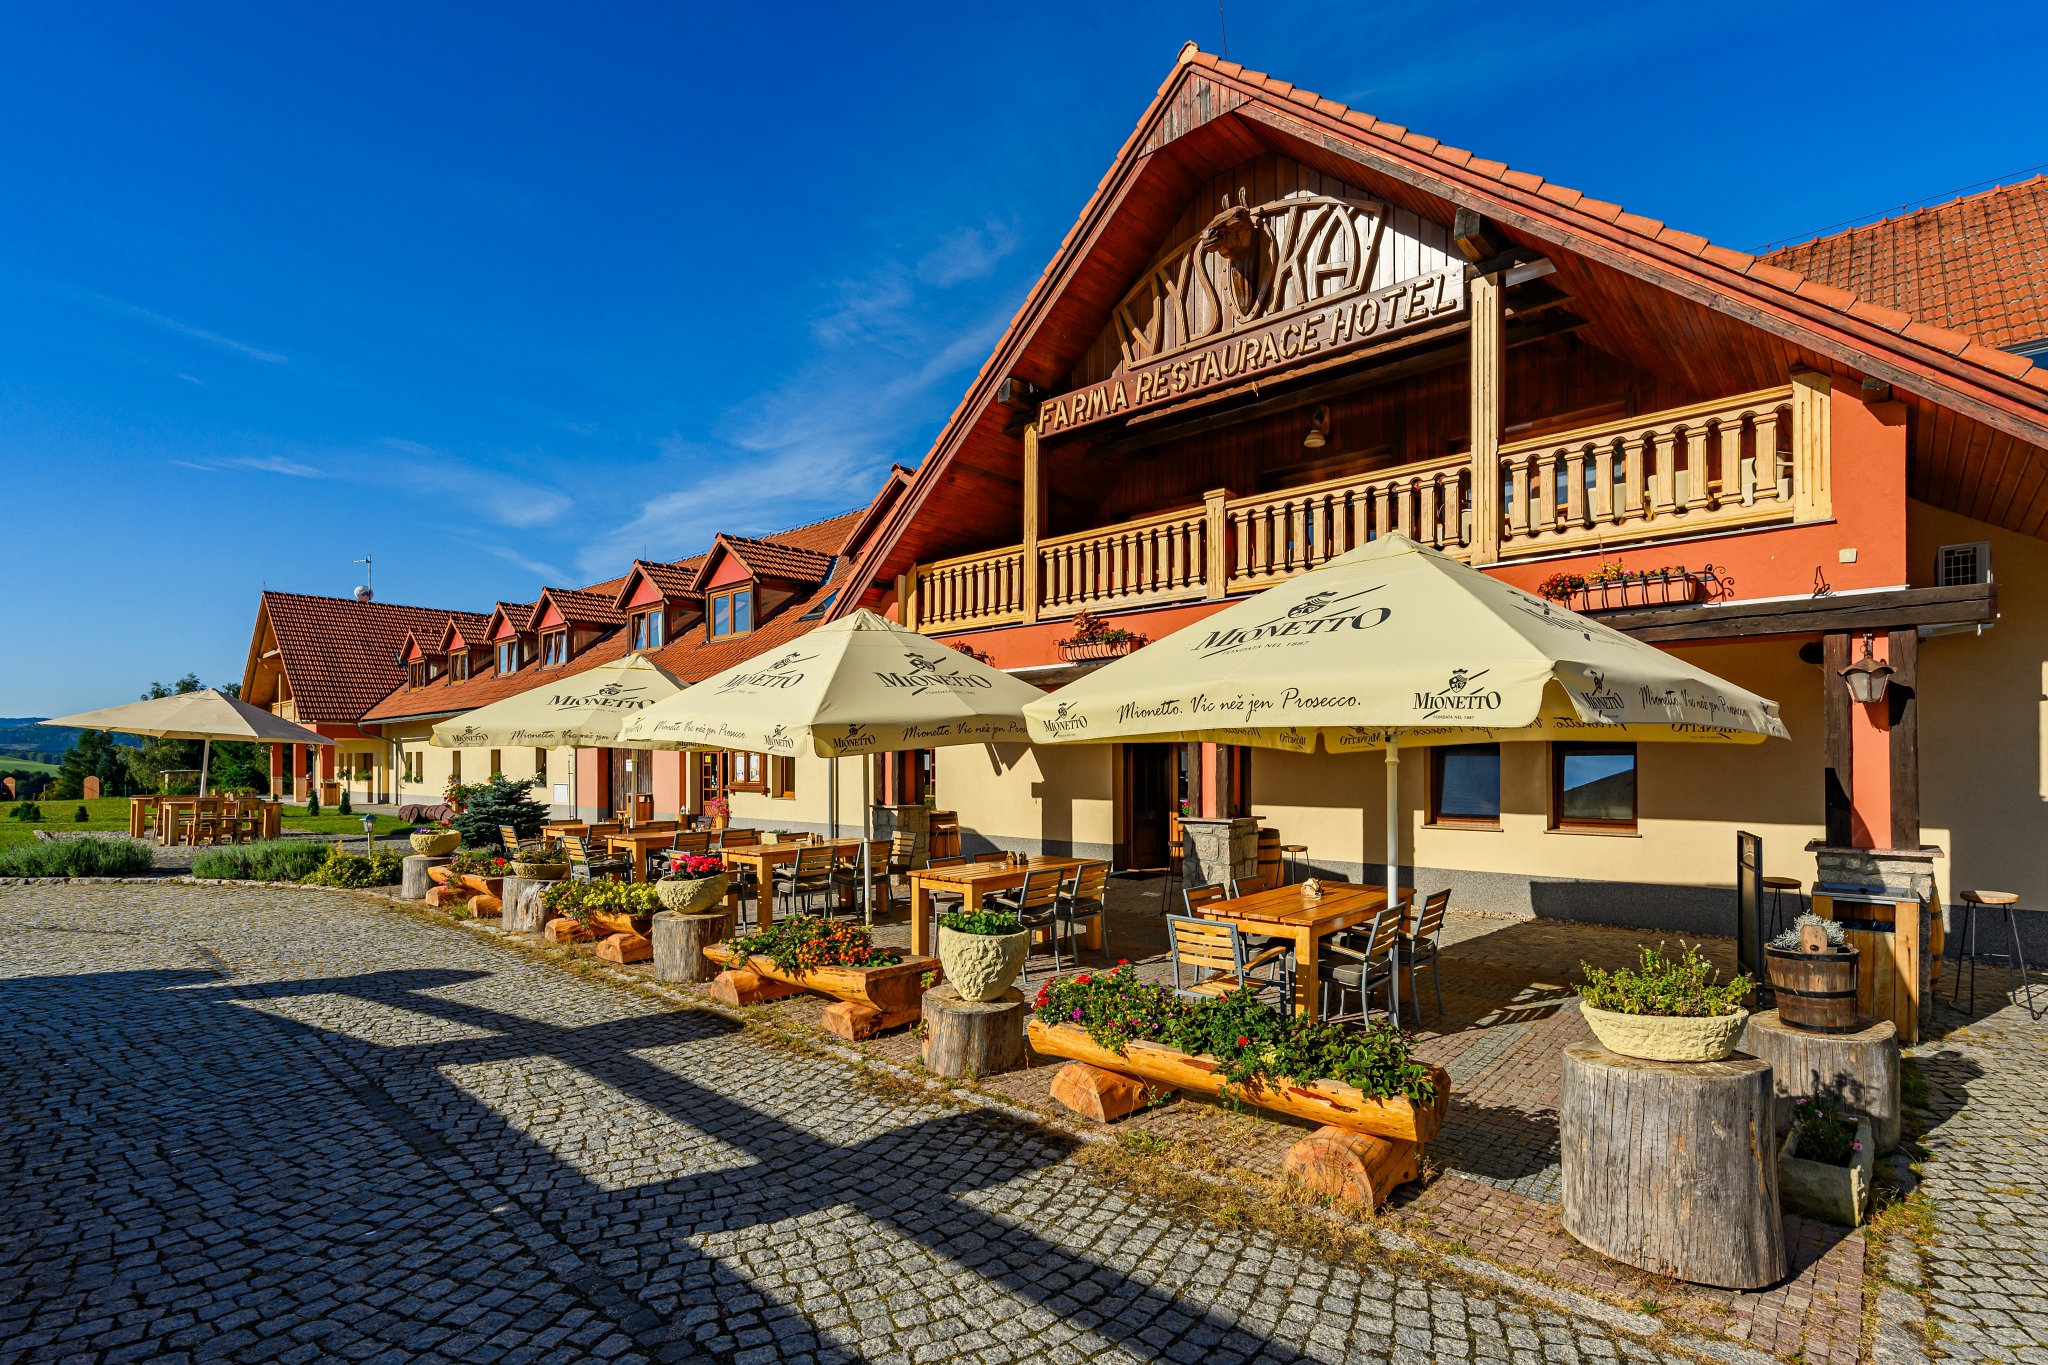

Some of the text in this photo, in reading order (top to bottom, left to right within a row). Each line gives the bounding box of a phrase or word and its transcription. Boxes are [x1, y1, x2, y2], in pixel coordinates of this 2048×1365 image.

[1039, 274, 1457, 434] FARMA RESTAURACE HOTEL
[1190, 608, 1392, 651] MIONETTO
[872, 672, 993, 688] MIONETTO
[1117, 700, 1183, 723] Mionetto.
[1220, 694, 1244, 710] než
[1246, 693, 1274, 722] jen
[1280, 687, 1361, 709] Prosecco.
[1412, 691, 1502, 710] MIONETTO
[1043, 716, 1088, 731] MIONETTO
[833, 735, 876, 748] MIONETTO
